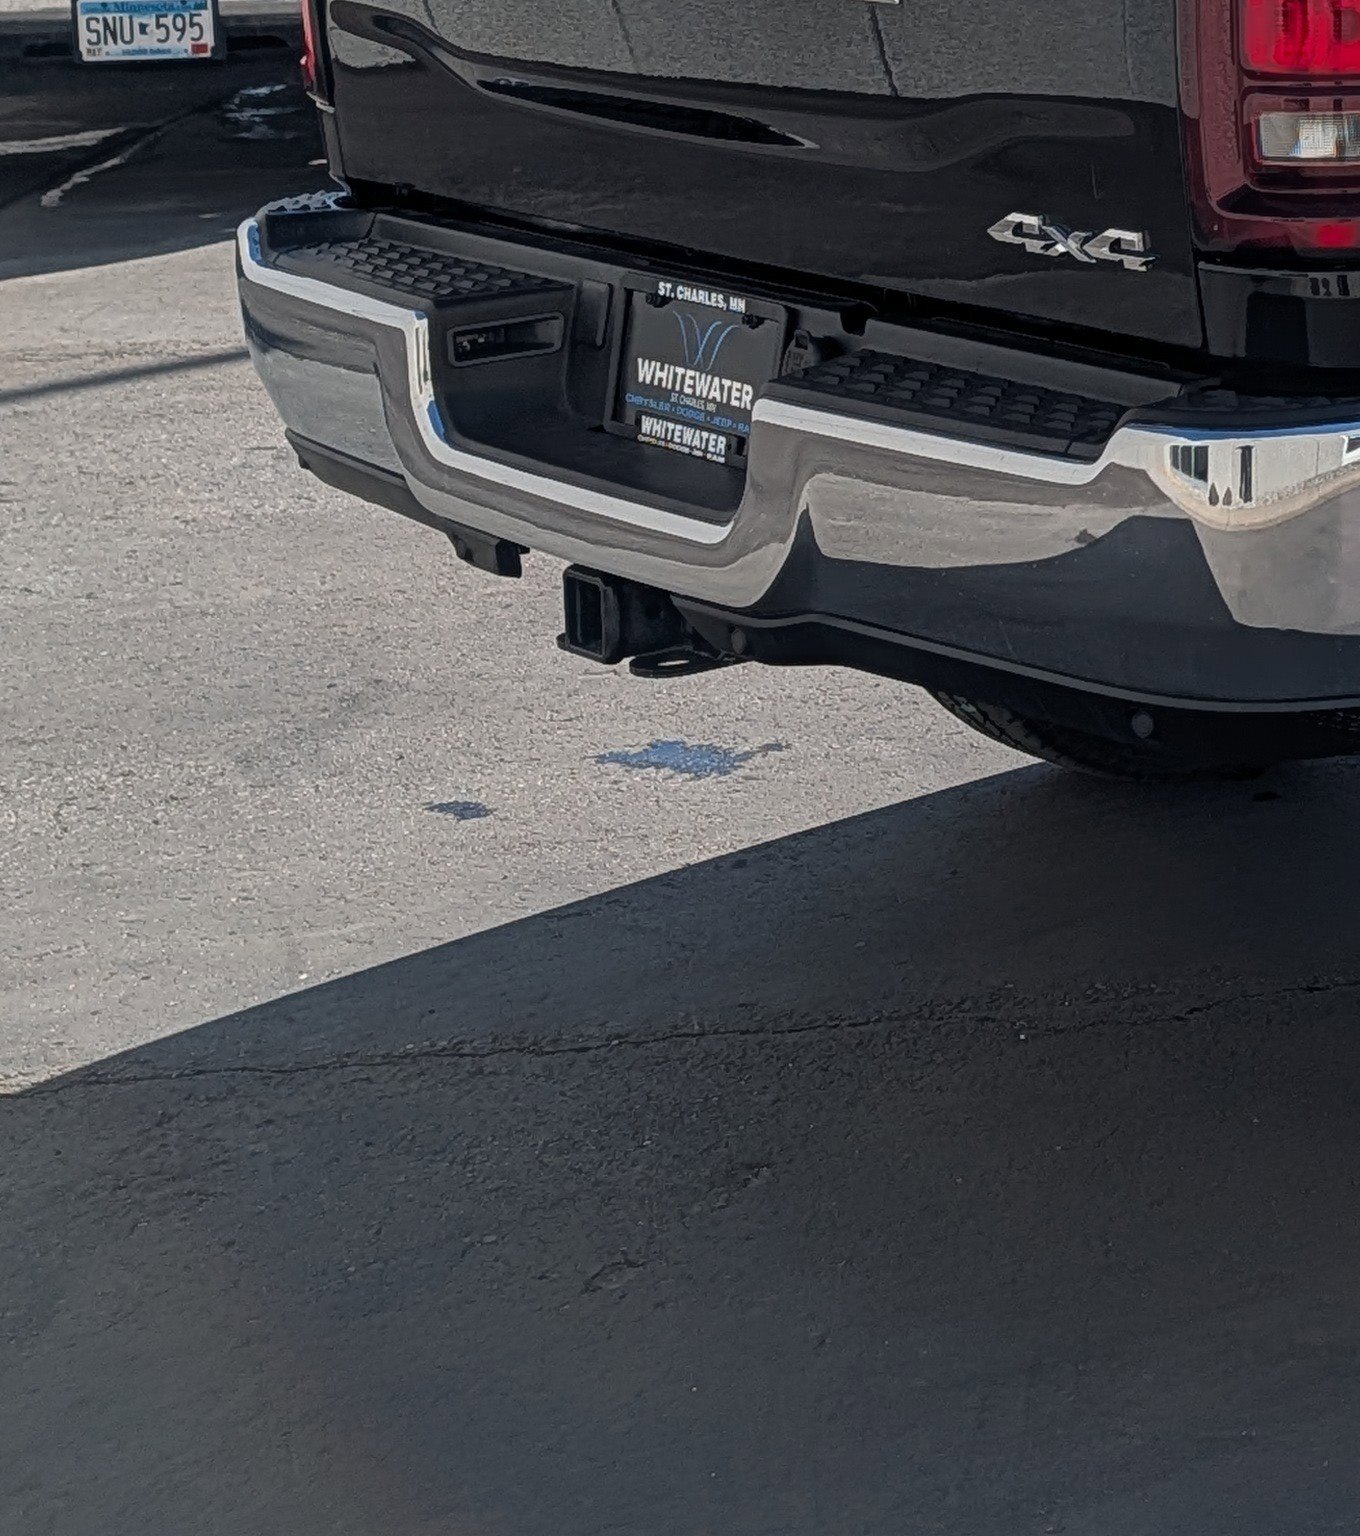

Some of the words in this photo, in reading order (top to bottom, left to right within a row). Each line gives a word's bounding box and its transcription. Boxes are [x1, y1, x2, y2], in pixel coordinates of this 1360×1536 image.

[85, 14, 135, 46] SNU
[155, 12, 204, 44] 595
[657, 281, 676, 299] ST.
[676, 284, 727, 311] CHARLES,
[637, 357, 754, 411] WHITEWATER
[641, 414, 727, 455] WHITEWATER
